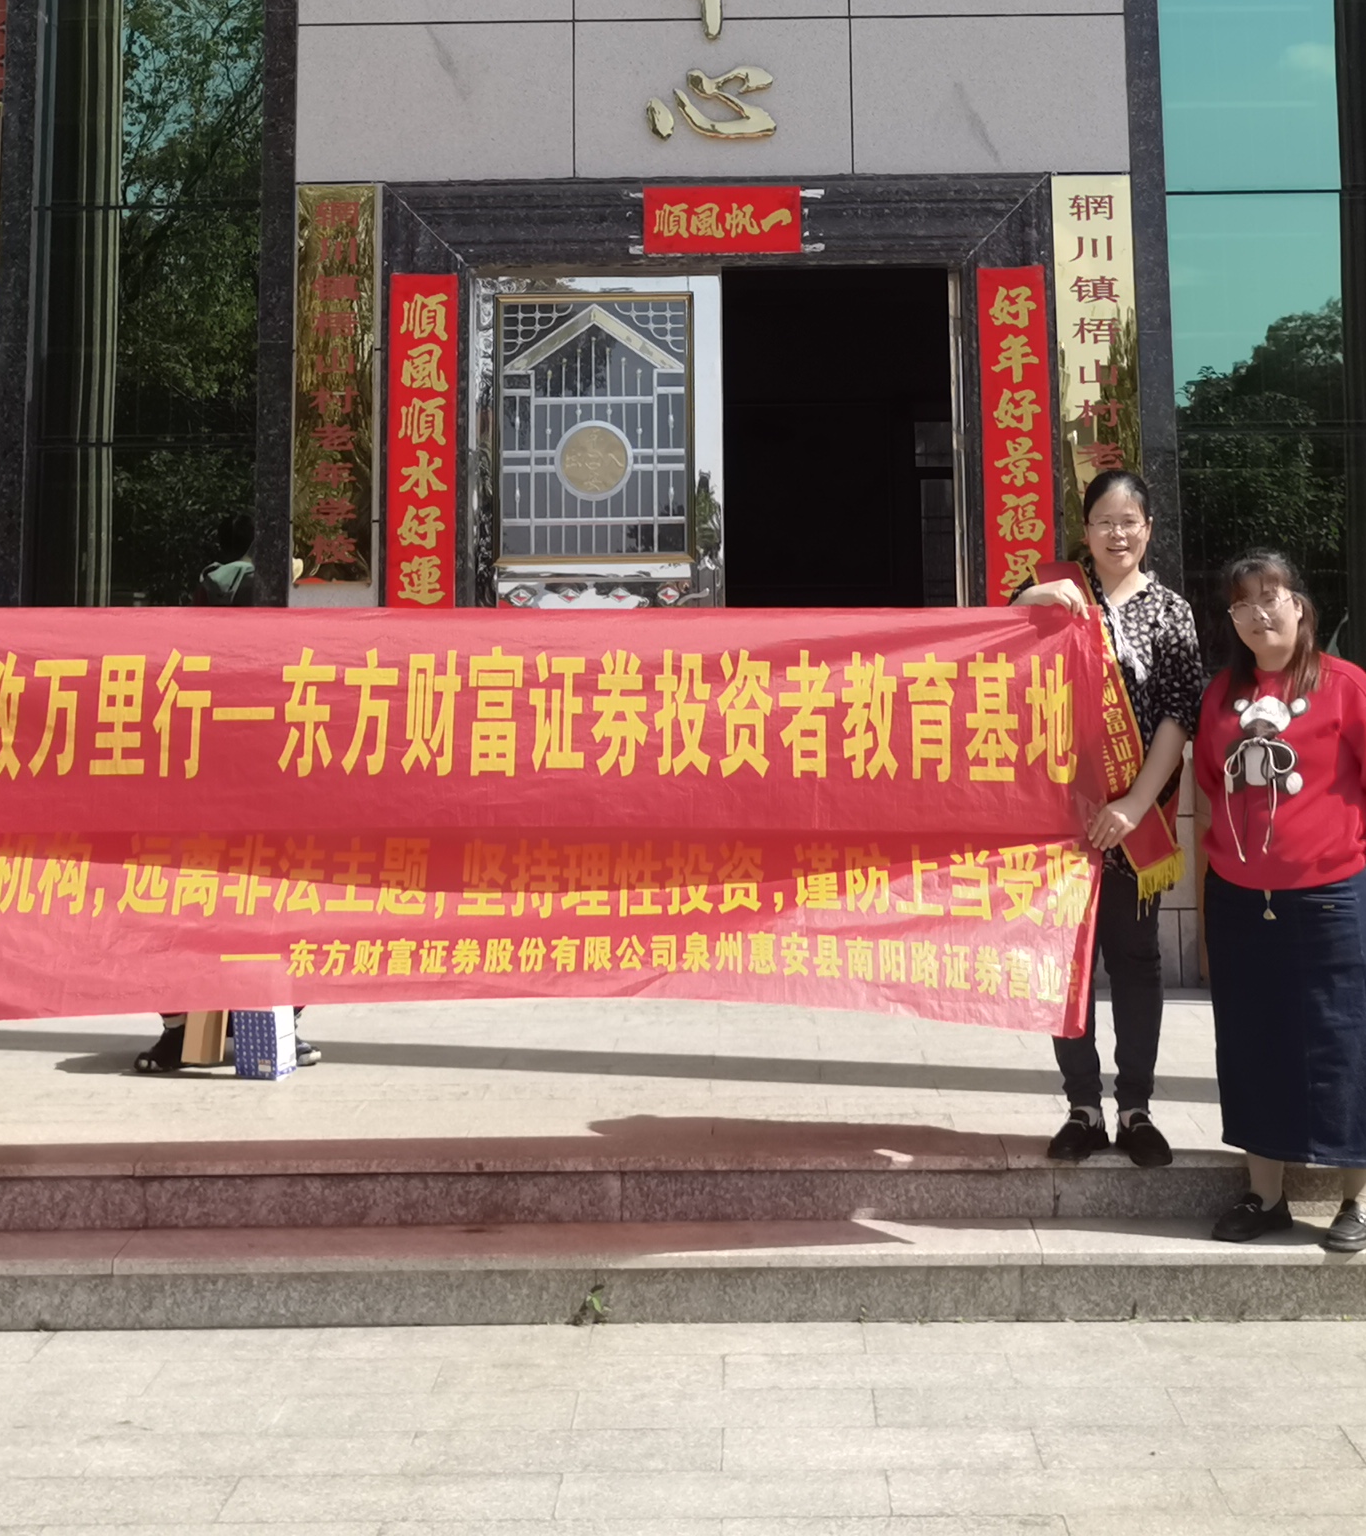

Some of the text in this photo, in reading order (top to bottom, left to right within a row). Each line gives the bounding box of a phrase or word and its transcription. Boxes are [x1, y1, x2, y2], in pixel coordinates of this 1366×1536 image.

[1069, 194, 1125, 470] 辋川镇梧山村老
